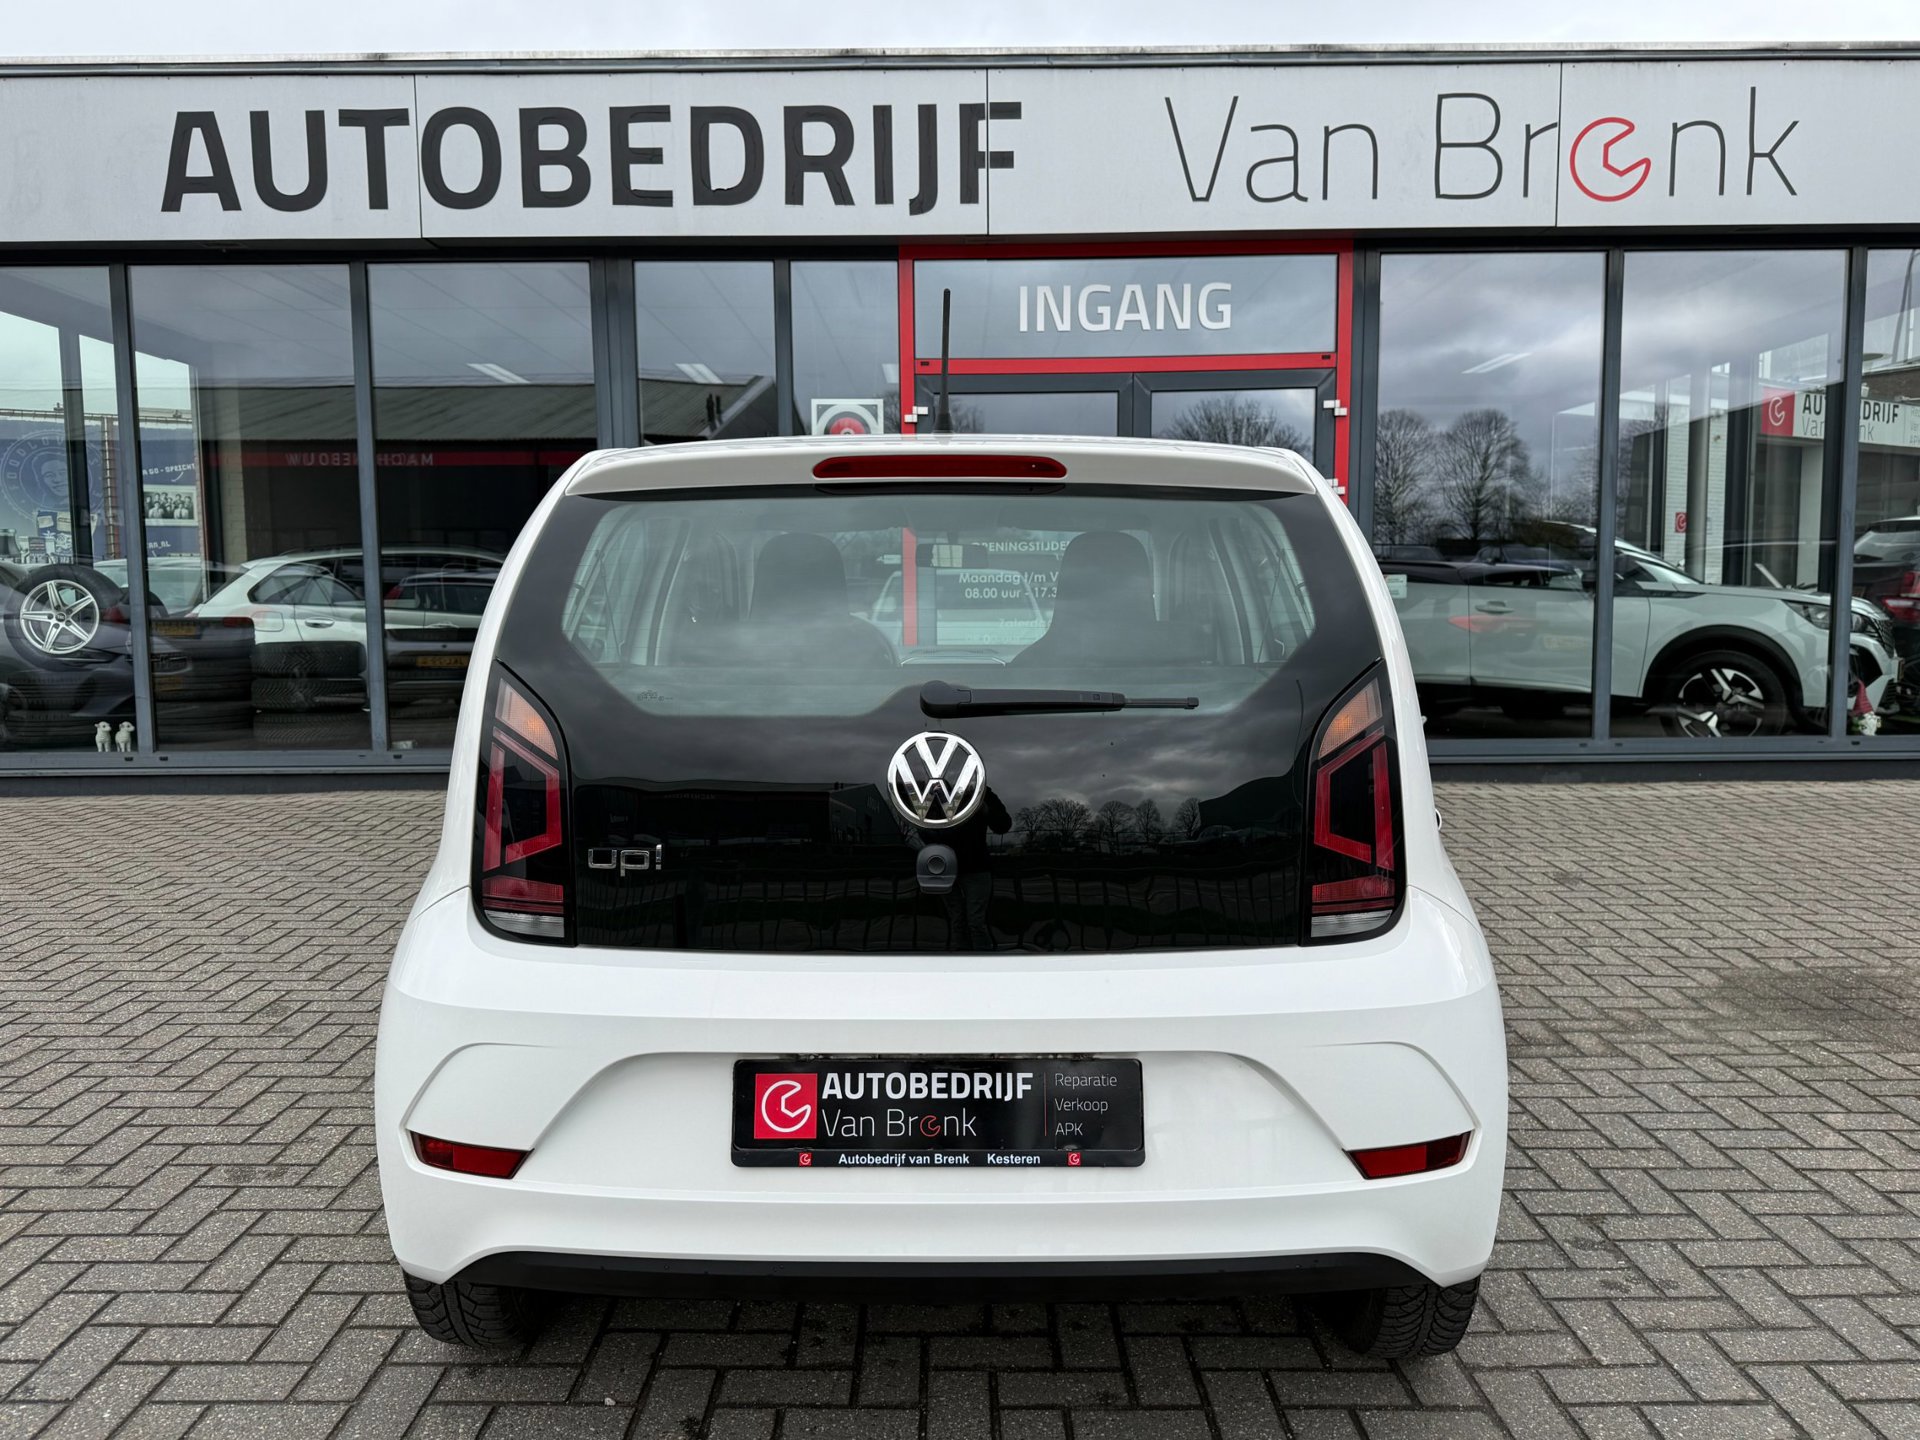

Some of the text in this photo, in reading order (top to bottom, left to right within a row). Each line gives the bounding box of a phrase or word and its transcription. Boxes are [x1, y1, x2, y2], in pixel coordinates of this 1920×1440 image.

[161, 101, 1022, 216] AUTOBEDRIJF
[1165, 95, 1378, 203] Van
[1018, 281, 1232, 332] INGANG
[959, 571, 1020, 585] Maandag
[964, 587, 999, 599] 08.00
[1001, 589, 1022, 599] uur
[1034, 587, 1058, 599] 17.3
[587, 843, 663, 878] up!
[821, 1071, 1034, 1102] AUTOBEDRIJF
[1054, 1072, 1118, 1089] Reparatie
[1054, 1097, 1109, 1114] Verkoop
[821, 1108, 876, 1138] Van
[1054, 1122, 1084, 1137] APK
[838, 1152, 1042, 1167] Autobedrijf van Brenk Kesteren
